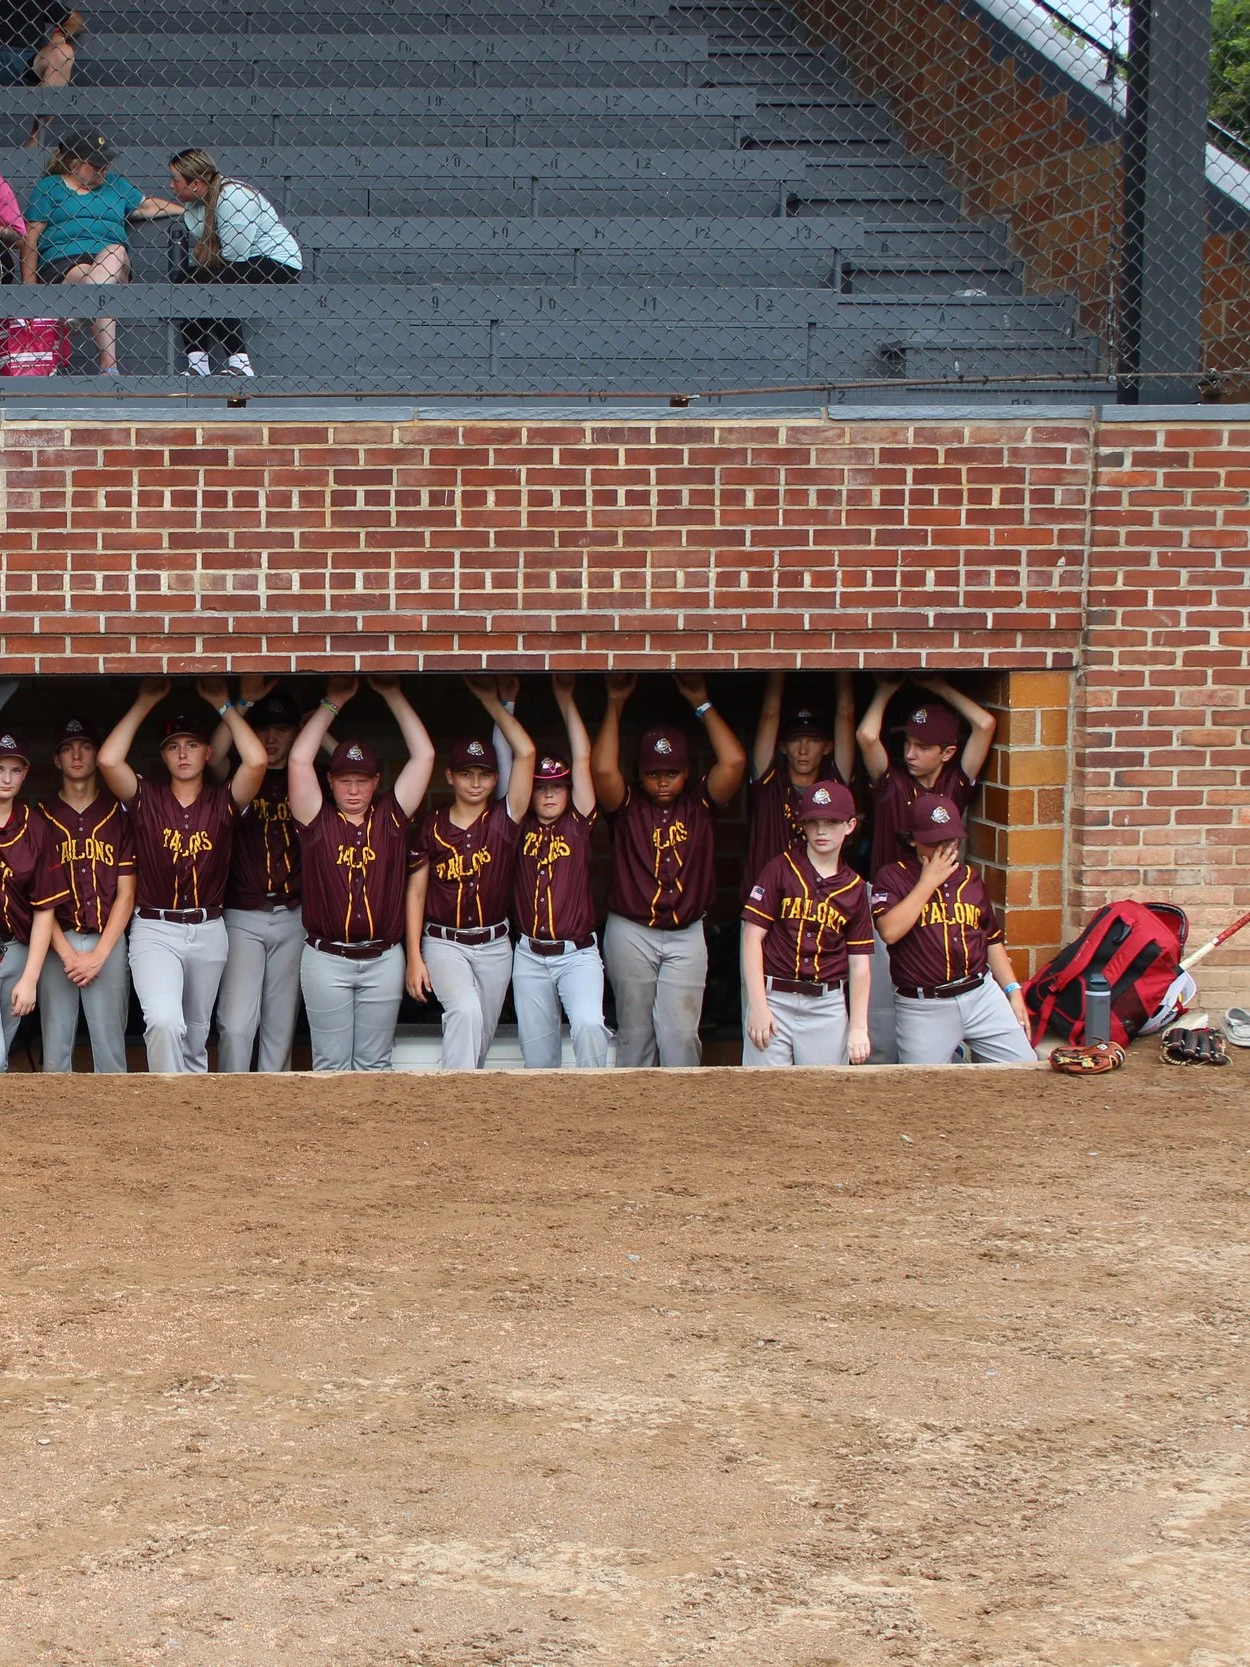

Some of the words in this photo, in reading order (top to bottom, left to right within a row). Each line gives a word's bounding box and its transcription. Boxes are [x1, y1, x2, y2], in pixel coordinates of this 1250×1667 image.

[636, 157, 651, 169] 12
[695, 226, 710, 239] 12
[538, 297, 556, 309] 10
[644, 298, 656, 311] 11
[755, 298, 773, 311] 12
[56, 839, 113, 866] ALONS
